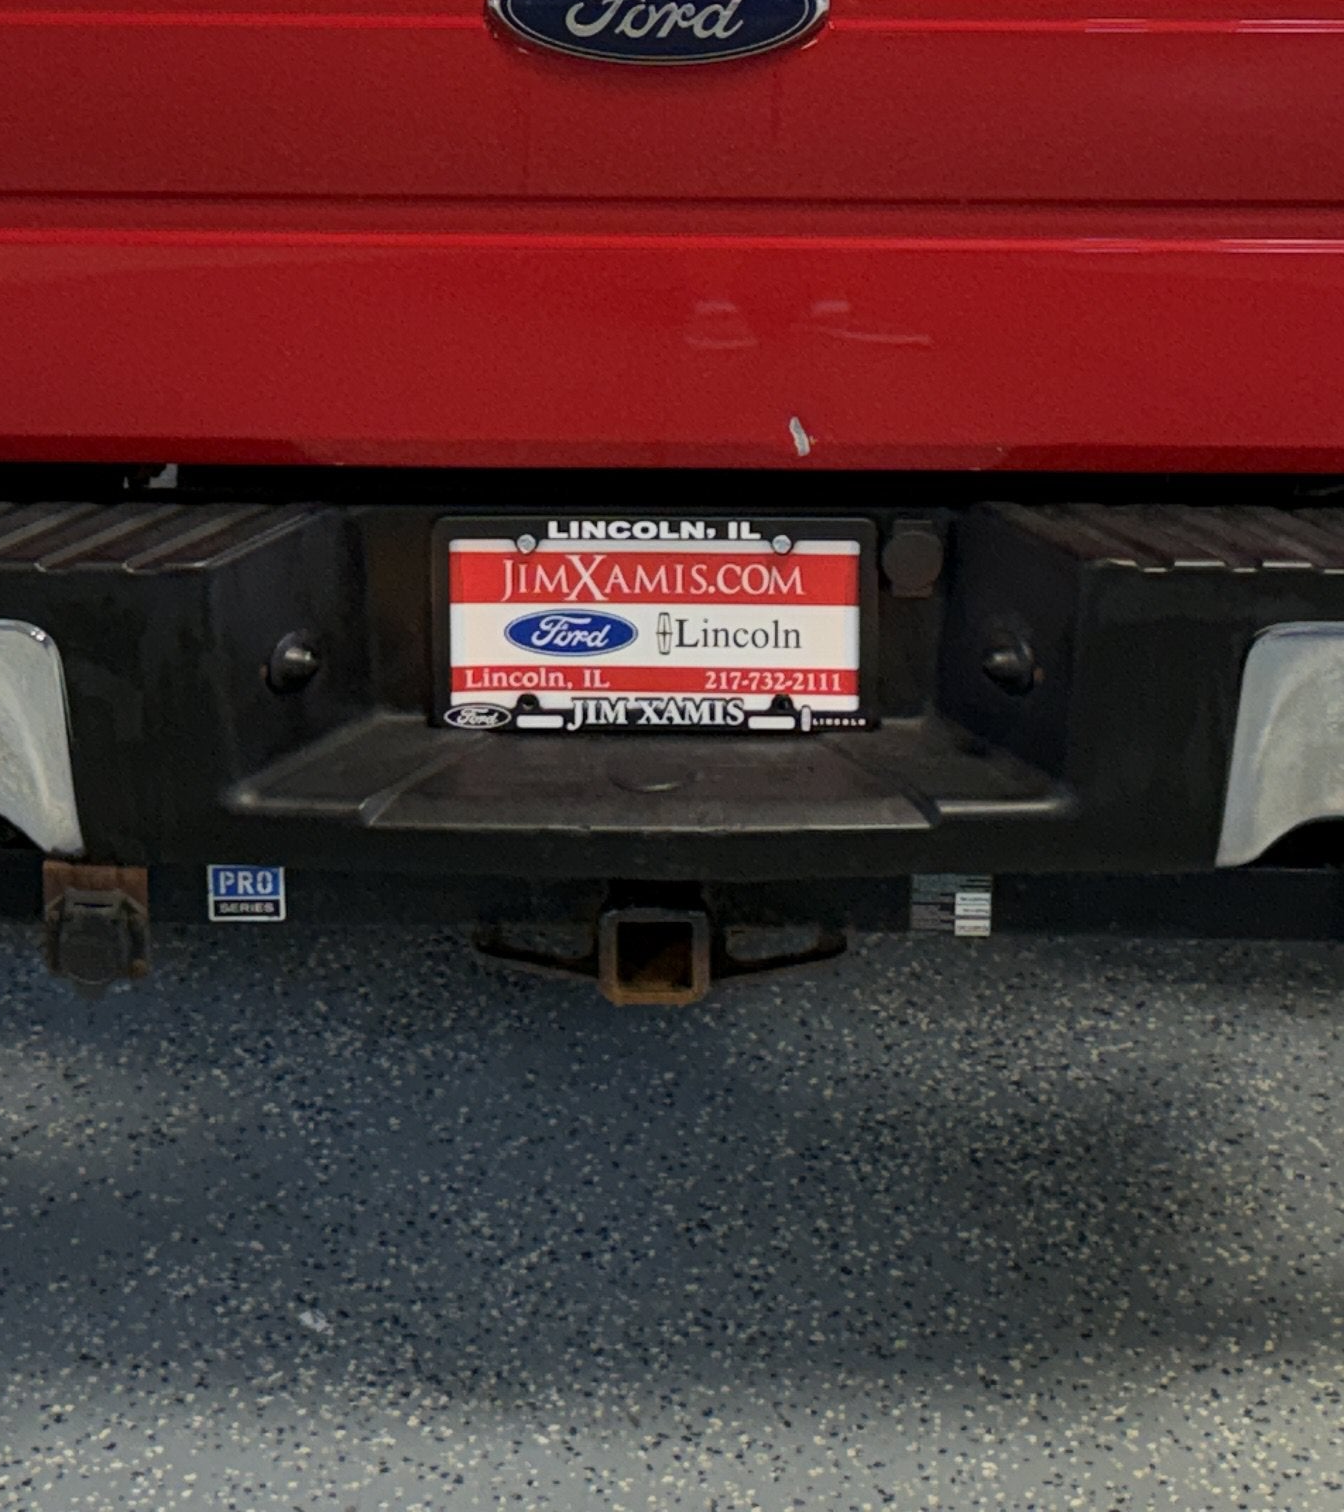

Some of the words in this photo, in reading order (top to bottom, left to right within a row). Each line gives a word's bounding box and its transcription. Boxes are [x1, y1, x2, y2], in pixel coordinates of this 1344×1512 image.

[547, 520, 717, 540] LINCOLN,
[727, 521, 761, 540] IL
[500, 554, 804, 602] JIMXAMIS.COM
[531, 615, 611, 648] Ford
[675, 618, 802, 650] Lincoln
[464, 668, 573, 690] Lincoln,
[582, 669, 611, 688] IL
[704, 671, 842, 692] 217-732-2111
[566, 698, 629, 731] JIM
[635, 698, 745, 726] XAMIS
[219, 870, 273, 895] PRO
[219, 901, 275, 914] SERIES
